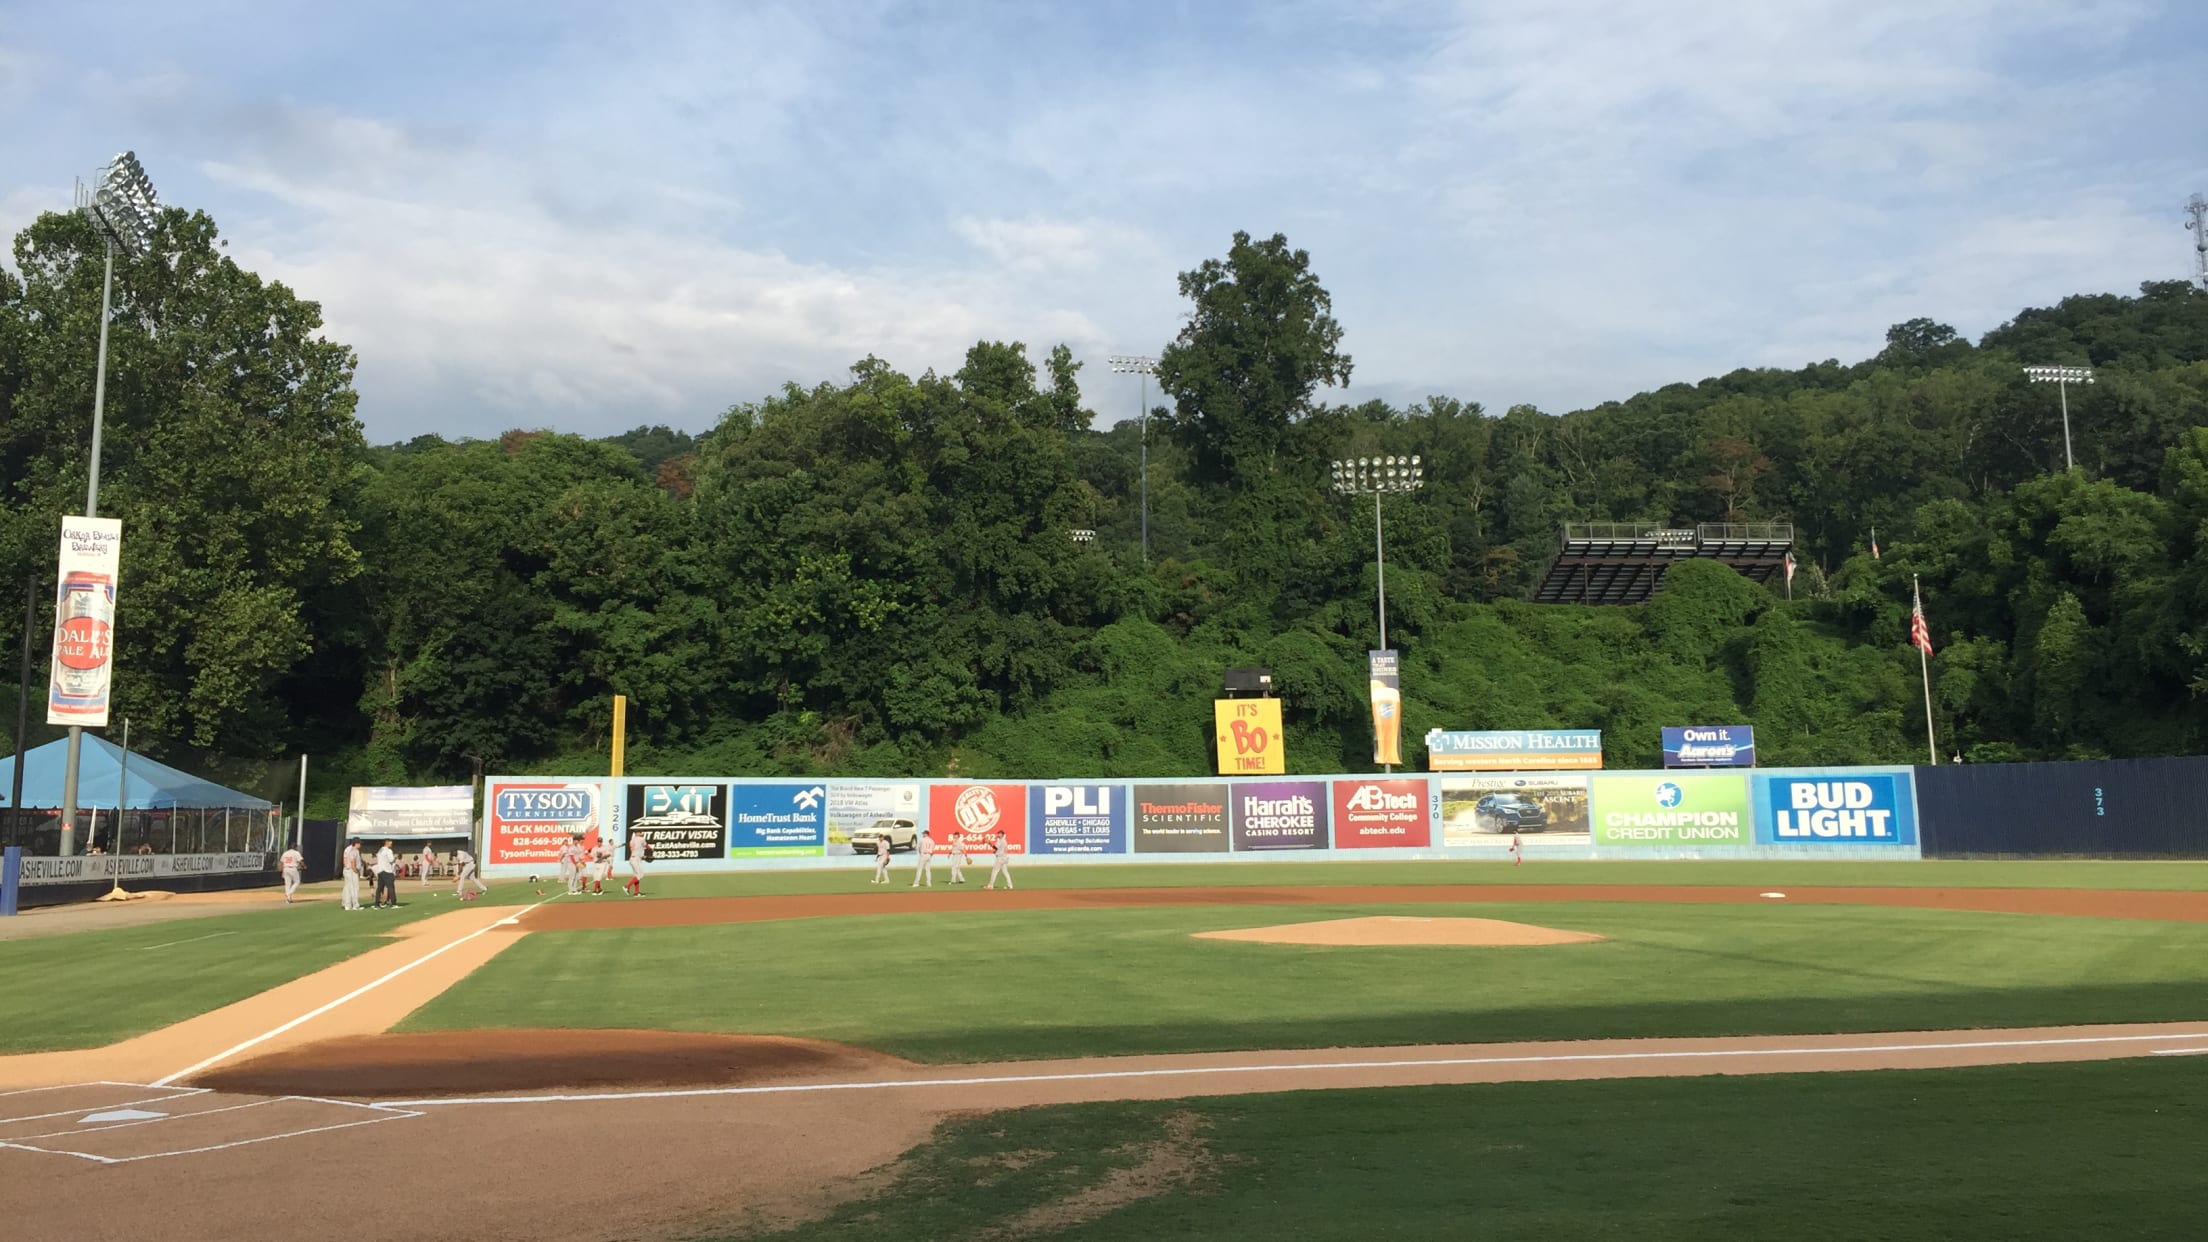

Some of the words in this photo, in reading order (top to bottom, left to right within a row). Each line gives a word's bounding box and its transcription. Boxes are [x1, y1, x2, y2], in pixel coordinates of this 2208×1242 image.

[58, 628, 110, 645] DALE'S
[1237, 704, 1258, 717] IT'S
[1684, 729, 1716, 741] Own
[1718, 729, 1732, 740] it.
[1453, 735, 1523, 750] MISSION
[1527, 734, 1599, 749] HEALTH
[1678, 743, 1736, 758] Aaron's
[1235, 757, 1266, 770] TIME!
[504, 792, 585, 810] TYSON
[1045, 786, 1110, 815] PLI
[1790, 782, 1873, 810] BUD
[2095, 788, 2104, 816] 373
[1140, 802, 1222, 814] ThermoFisher
[738, 813, 790, 823] HomeTrust
[792, 812, 817, 822] Bank
[1142, 814, 1222, 822] SCIENTIFIC
[1245, 816, 1314, 828] CHEROKEE
[1348, 814, 1388, 822] Community
[1390, 812, 1418, 822] College
[1606, 812, 1738, 827] CHAMPION
[1777, 809, 1891, 837] LIGHT
[501, 825, 532, 834] BLACK
[534, 824, 586, 834] MOUNTAIN
[653, 830, 686, 840] REALTY
[688, 830, 718, 840] VISTAS
[1045, 826, 1057, 834] LAS
[1058, 826, 1078, 834] VEGAS
[1092, 826, 1110, 834] LOUIS
[1282, 828, 1314, 836] RESORT
[1360, 826, 1406, 835] abtech.edu
[1606, 827, 1673, 840] CREDIT
[1678, 826, 1740, 839] UNION
[20, 860, 82, 879] ASHEVILLE.COM
[172, 855, 214, 872] ASHEVILLE.COM
